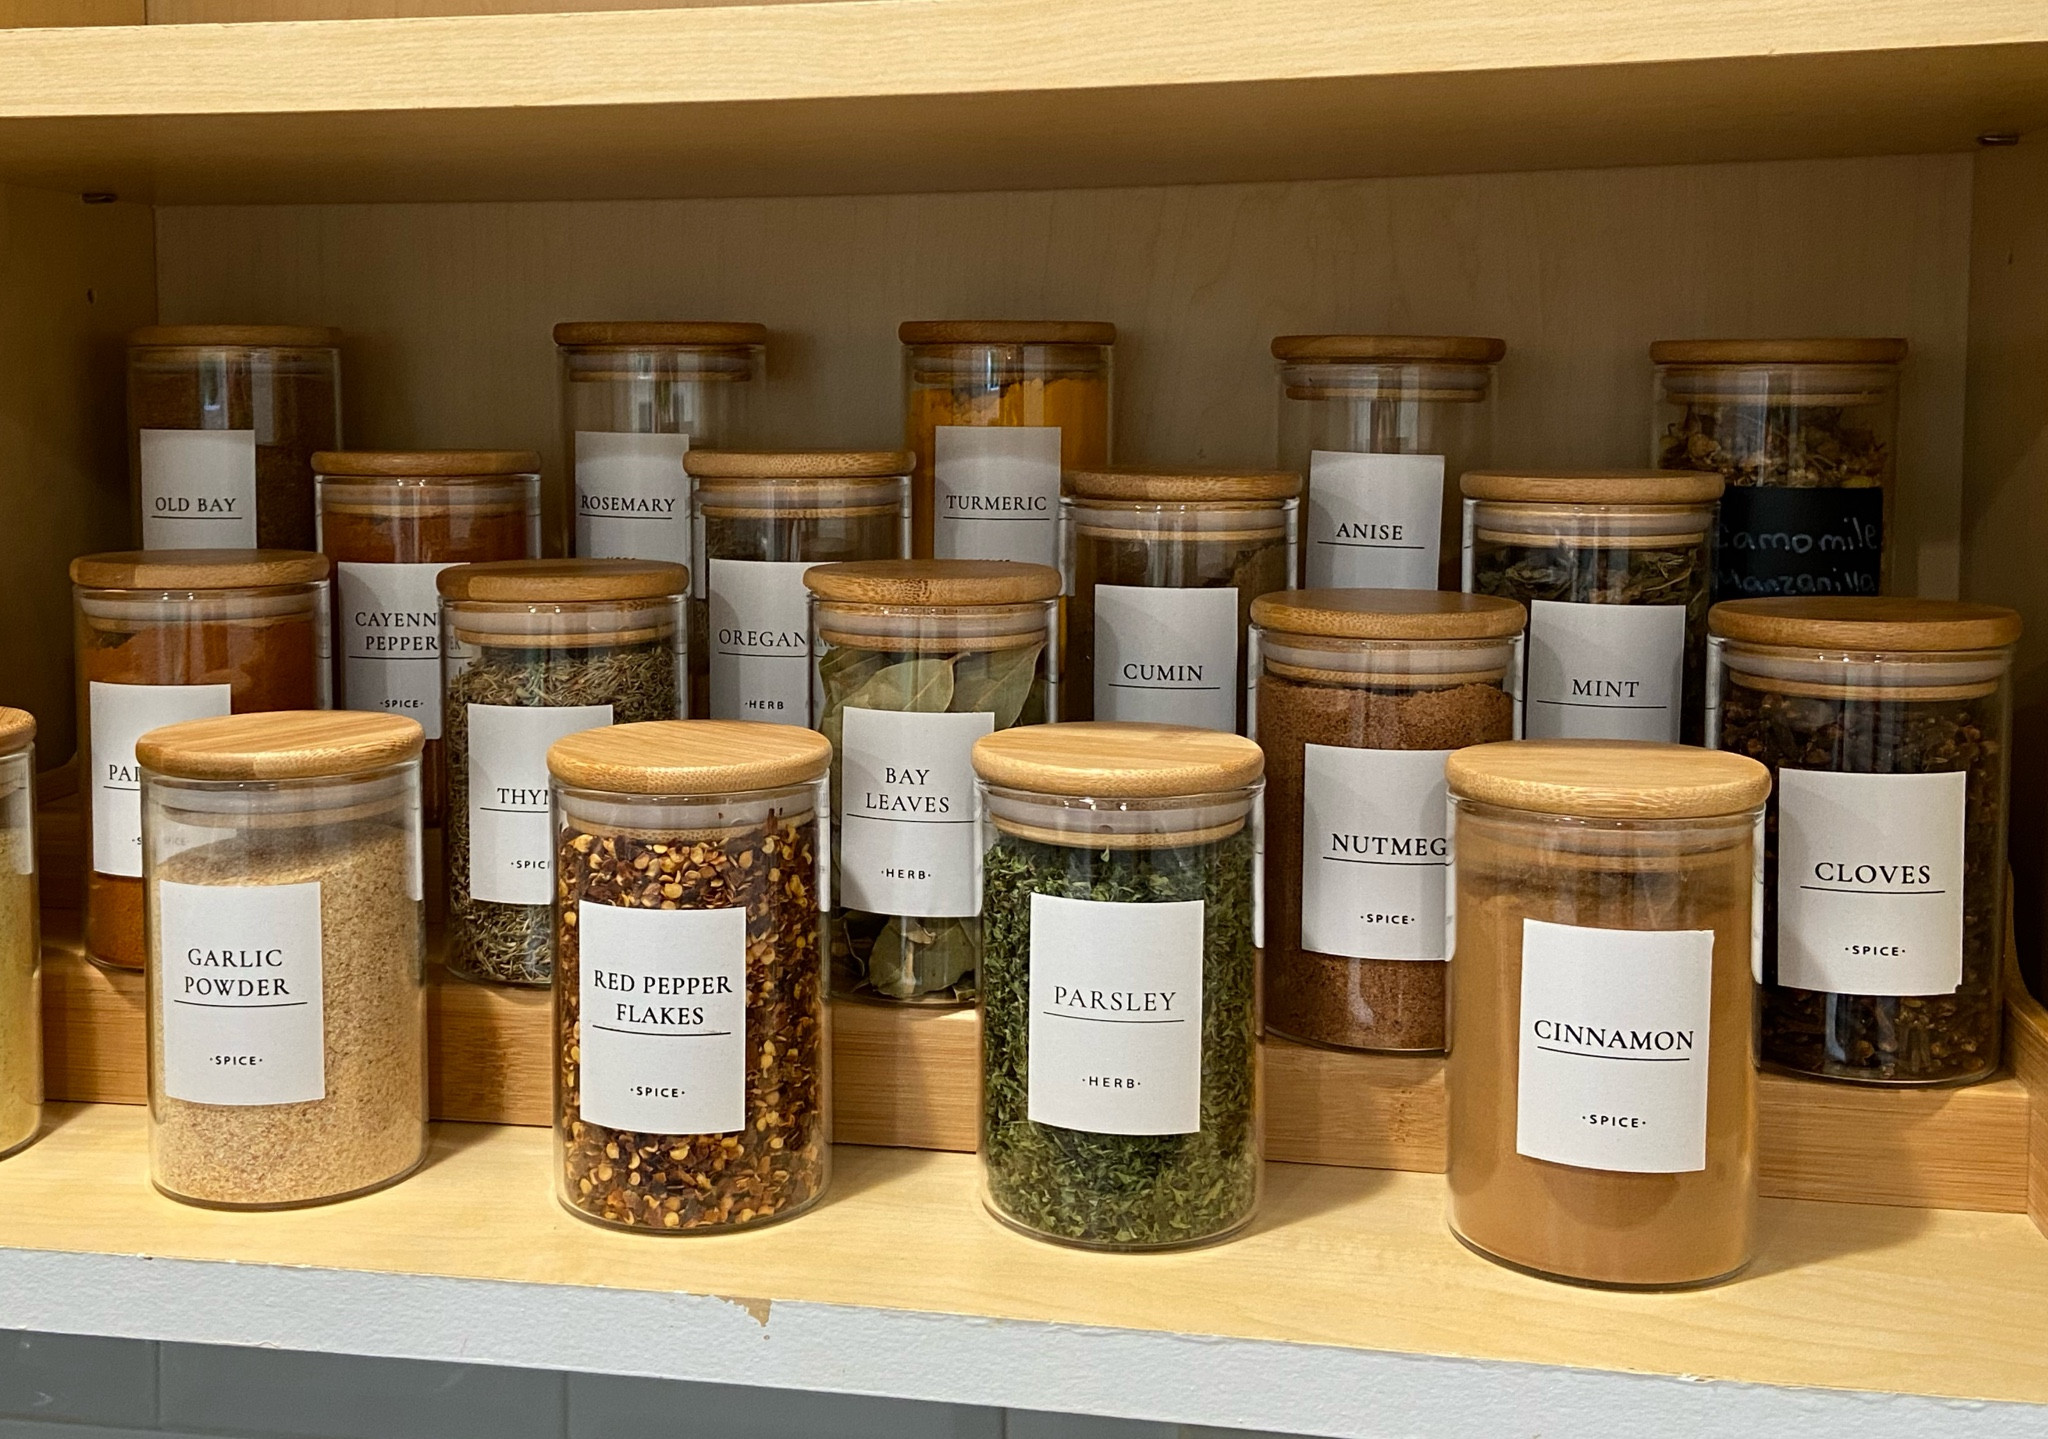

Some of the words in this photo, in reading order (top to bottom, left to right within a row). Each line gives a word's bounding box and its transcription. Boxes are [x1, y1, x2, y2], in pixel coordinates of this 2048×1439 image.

[155, 497, 190, 512] OLD
[198, 497, 237, 513] BAY
[581, 495, 676, 512] ROSEMARY
[946, 495, 1047, 511] TURMERIC
[1336, 523, 1404, 541] ANISE
[355, 611, 437, 627] CAYENN
[365, 635, 439, 651] PEPPER
[718, 629, 807, 647] OREGAN
[1123, 663, 1203, 681] CUMIN
[1572, 679, 1640, 698] MINT
[885, 768, 930, 786] BAY
[865, 792, 951, 813] LEAVES
[1331, 833, 1448, 857] NUTMEG
[510, 859, 551, 870] ·SPIC
[1815, 862, 1931, 884] CLOVES
[188, 948, 283, 968] GARLIC
[184, 977, 290, 997] POWDER
[594, 970, 635, 992] RED
[643, 974, 733, 995] PEPPER
[1054, 985, 1177, 1012] PARSLEY
[616, 1003, 705, 1025] FLAKES
[1533, 1019, 1694, 1050] CINNAMON
